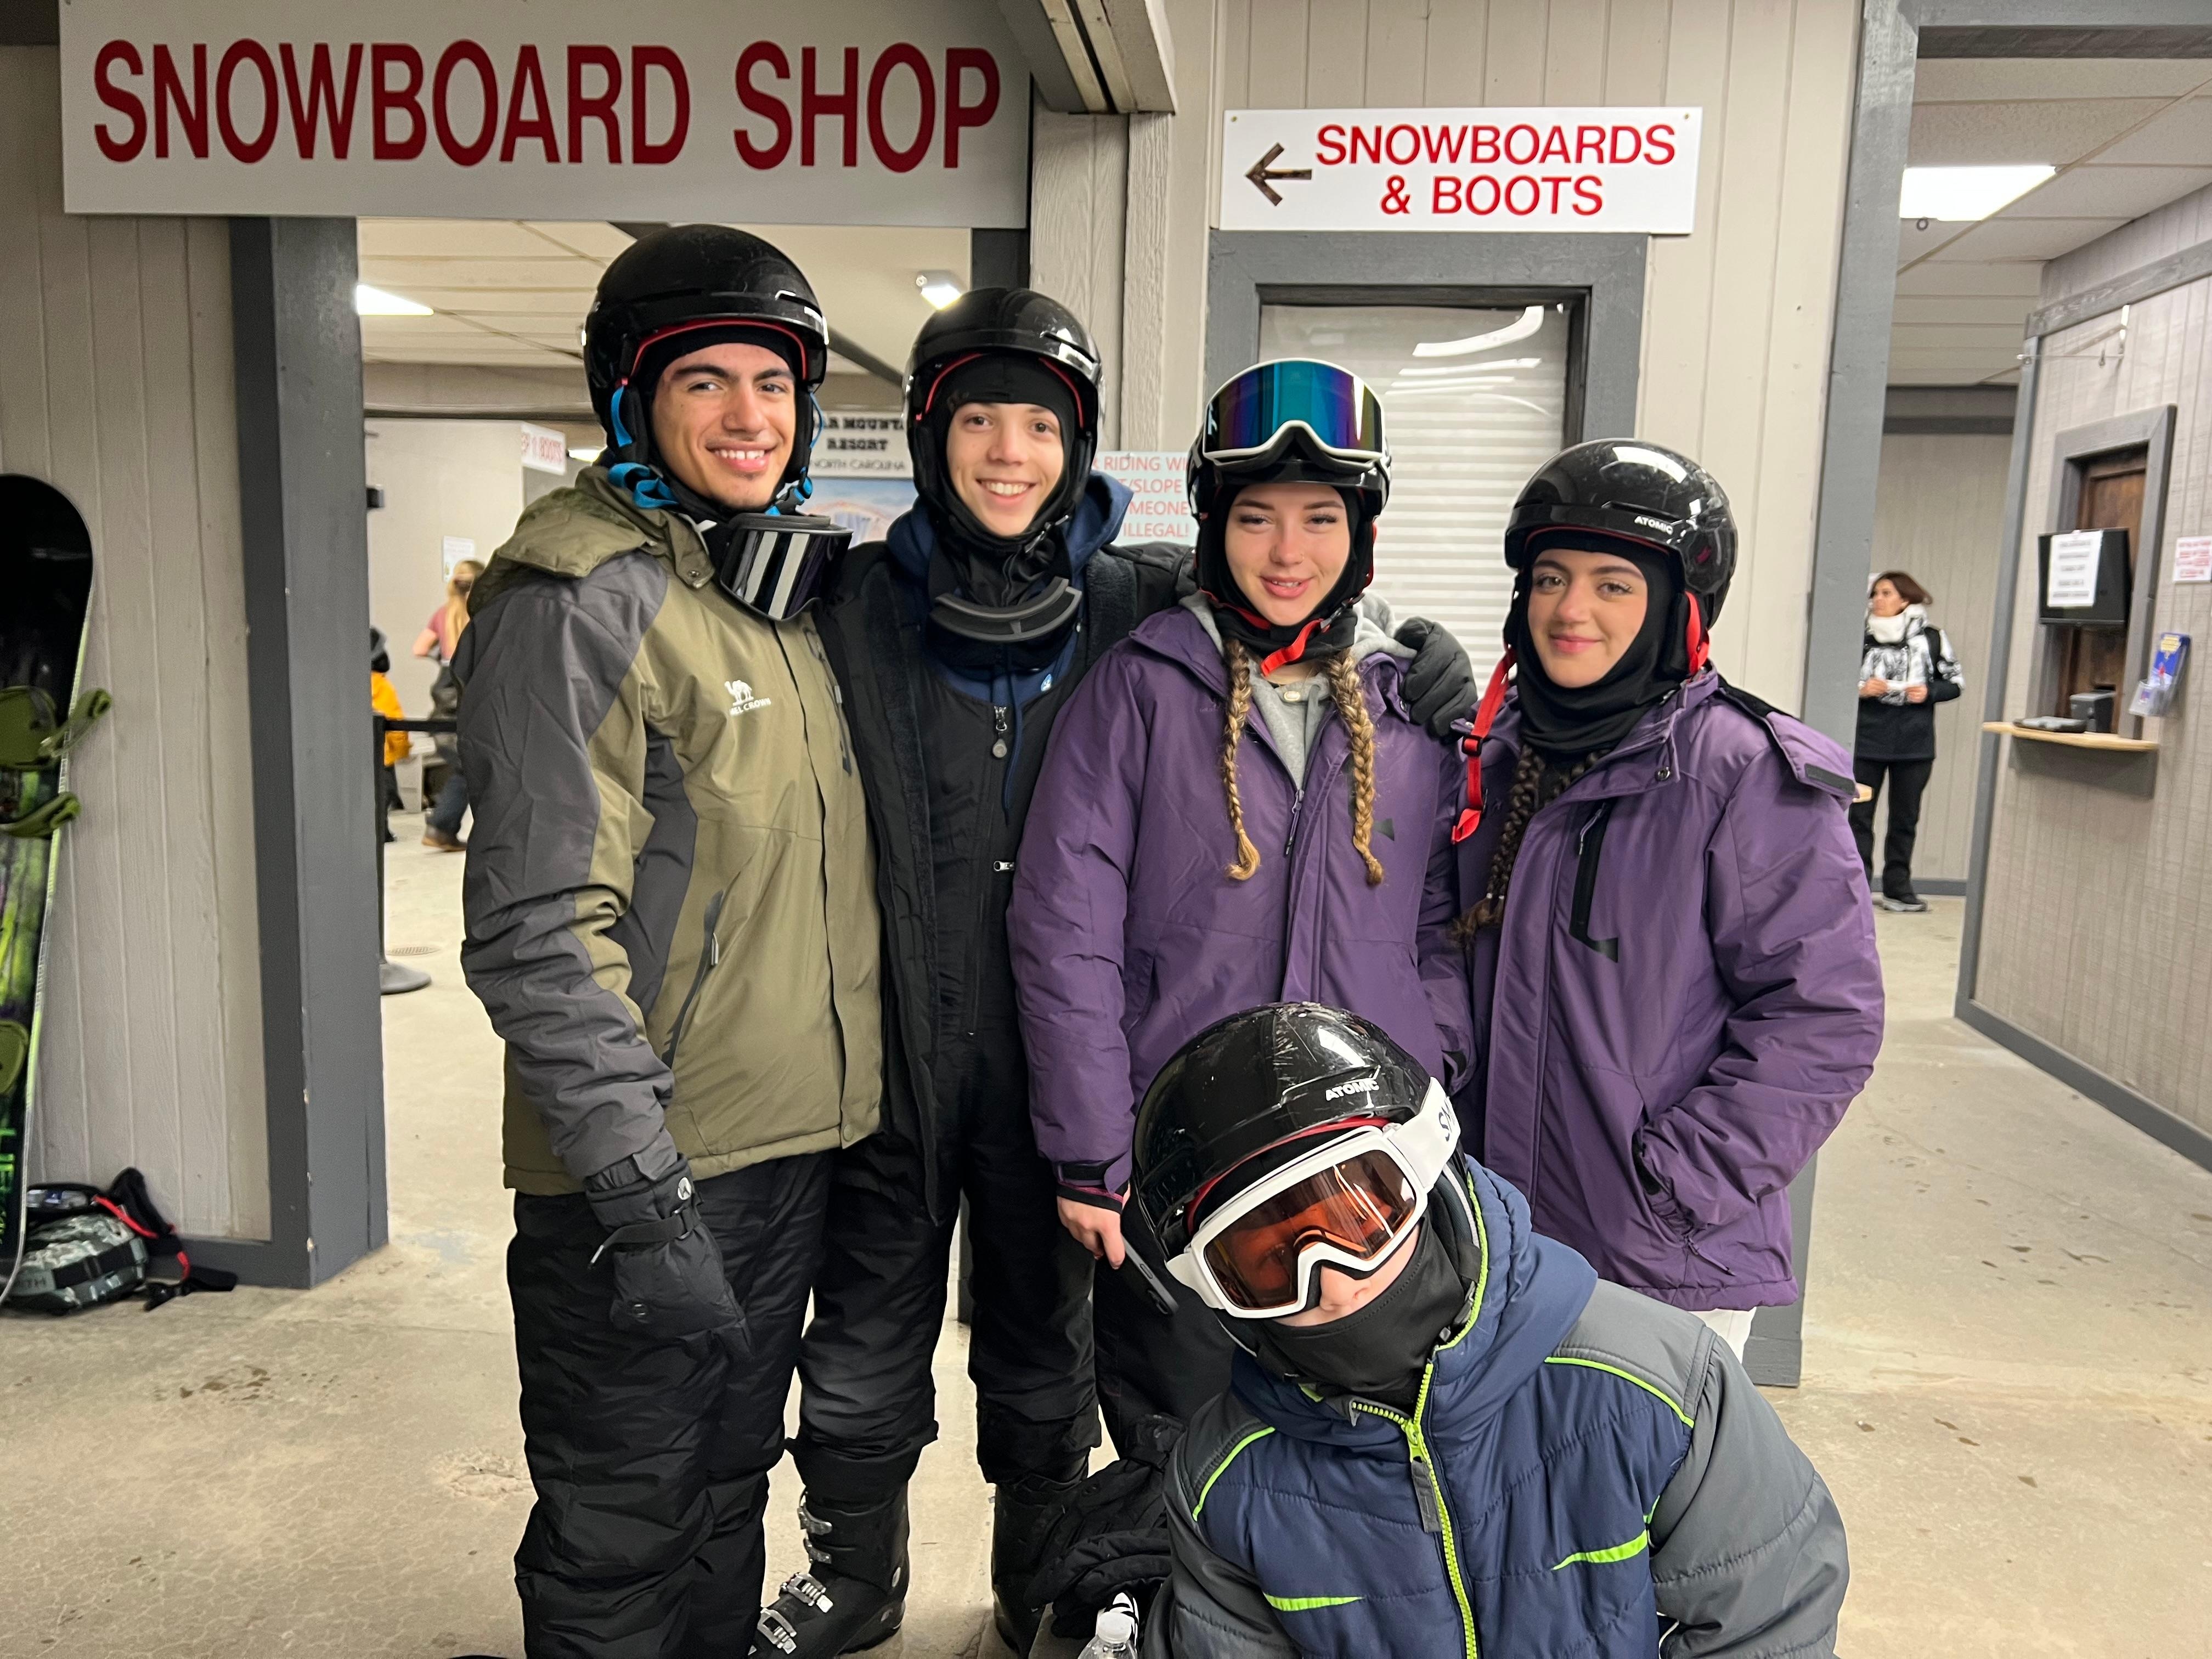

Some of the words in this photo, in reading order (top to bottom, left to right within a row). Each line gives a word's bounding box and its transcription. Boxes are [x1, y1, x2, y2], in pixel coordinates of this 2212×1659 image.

[94, 38, 690, 166] SNOWBOARD
[733, 41, 1001, 173] SHOP
[1317, 123, 1675, 165] SNOWBOARDS
[1381, 174, 1410, 215] &
[1432, 174, 1602, 216] BOOTS
[827, 438, 888, 451] RESORT
[1104, 456, 1161, 471] RIDING
[1166, 456, 1187, 471] WI
[1128, 500, 1188, 515] MEONE
[1123, 522, 1189, 537] ILLEGAL!
[1634, 516, 1673, 535] ATOMIC
[1325, 1079, 1380, 1101] ATOMIC
